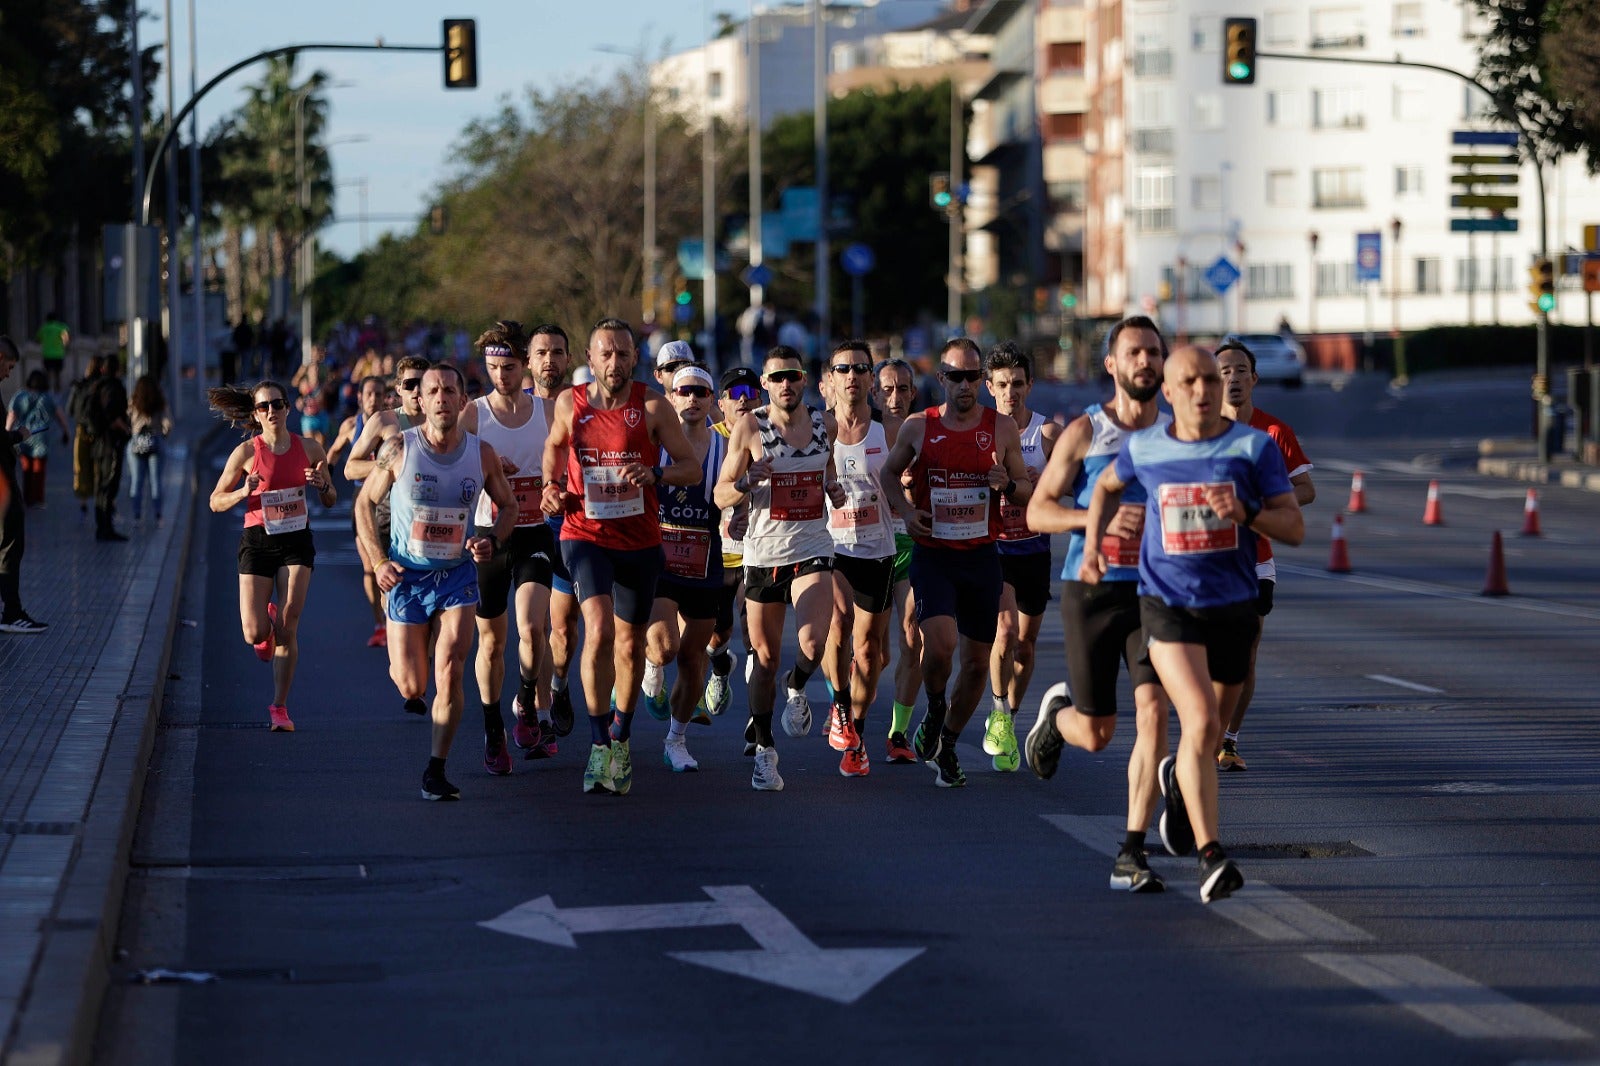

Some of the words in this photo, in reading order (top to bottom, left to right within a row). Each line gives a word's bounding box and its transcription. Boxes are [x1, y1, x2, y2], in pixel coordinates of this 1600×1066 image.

[790, 489, 808, 499] 575
[842, 510, 868, 520] 10316
[946, 507, 974, 516] 10376
[425, 525, 453, 536] 10509
[674, 545, 690, 555] 114
